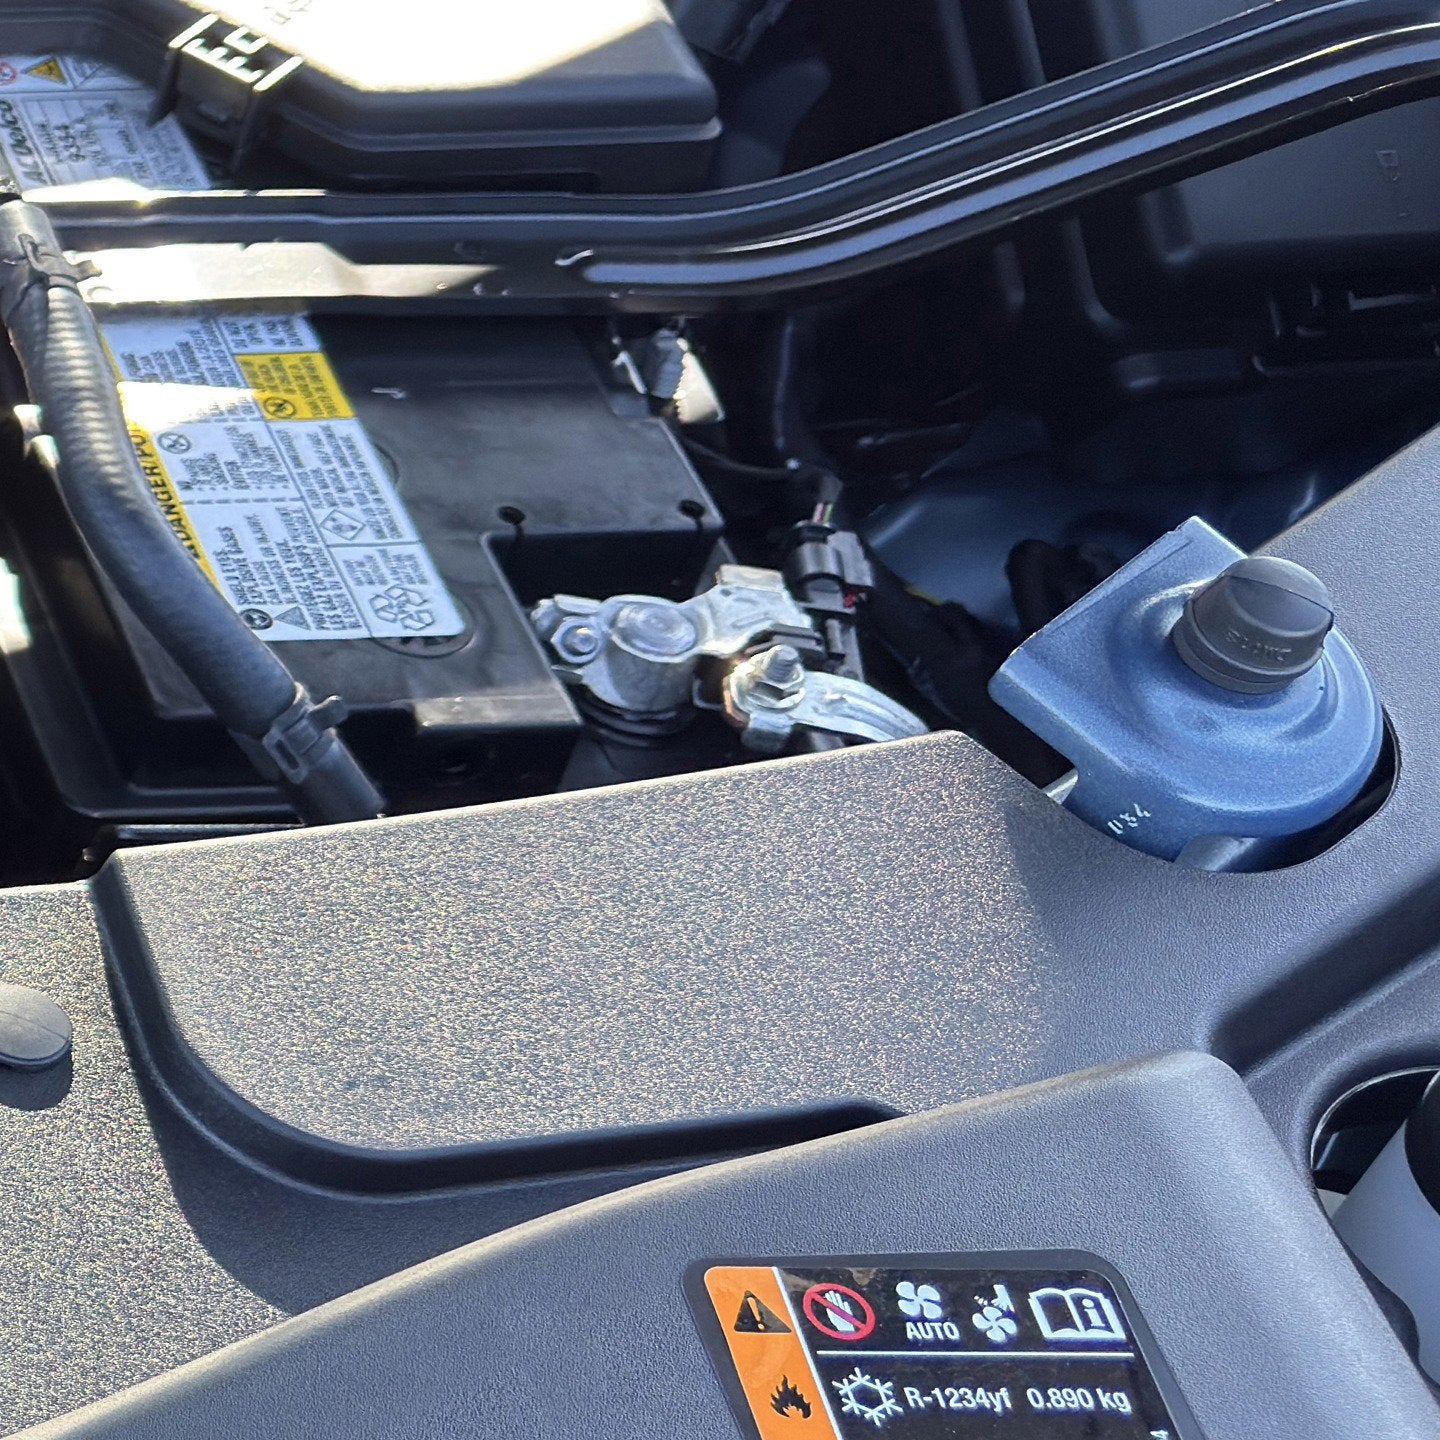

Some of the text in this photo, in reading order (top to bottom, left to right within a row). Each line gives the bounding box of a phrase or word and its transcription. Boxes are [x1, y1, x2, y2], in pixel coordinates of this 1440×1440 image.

[905, 1321, 961, 1340] AUTO
[903, 1386, 1133, 1418] R-1234yf 0.890 kg
